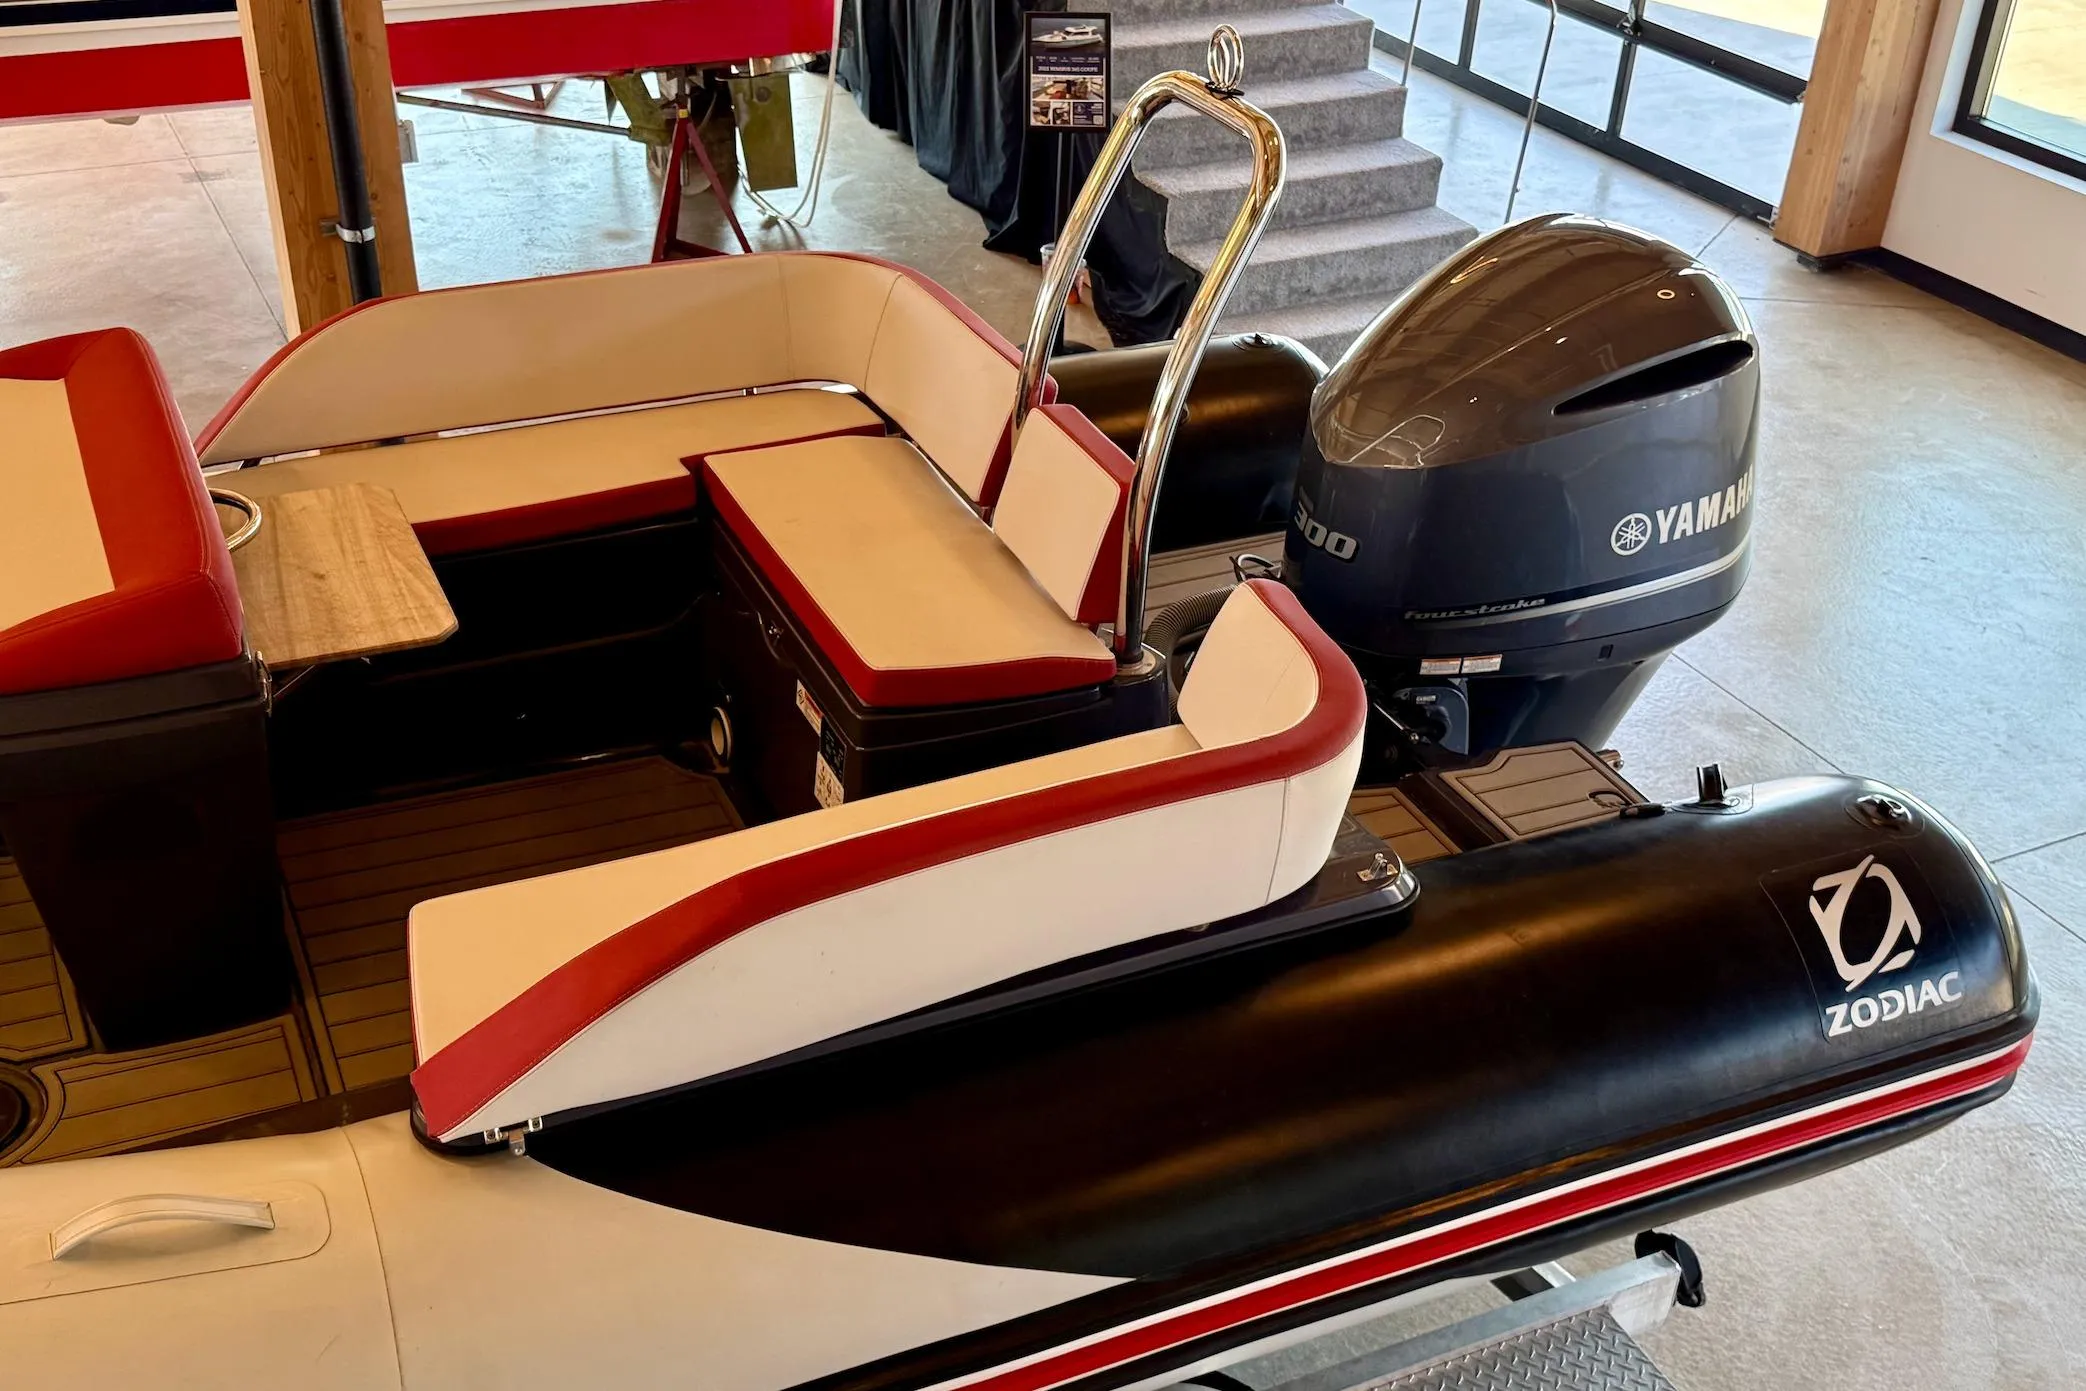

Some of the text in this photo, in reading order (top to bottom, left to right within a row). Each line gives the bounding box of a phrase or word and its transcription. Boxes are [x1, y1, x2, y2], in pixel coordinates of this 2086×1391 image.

[1294, 501, 1358, 560] 300
[1655, 463, 1754, 545] YAMAHA
[1404, 598, 1546, 620] fourstroke
[1825, 971, 1963, 1038] ZODIAC
